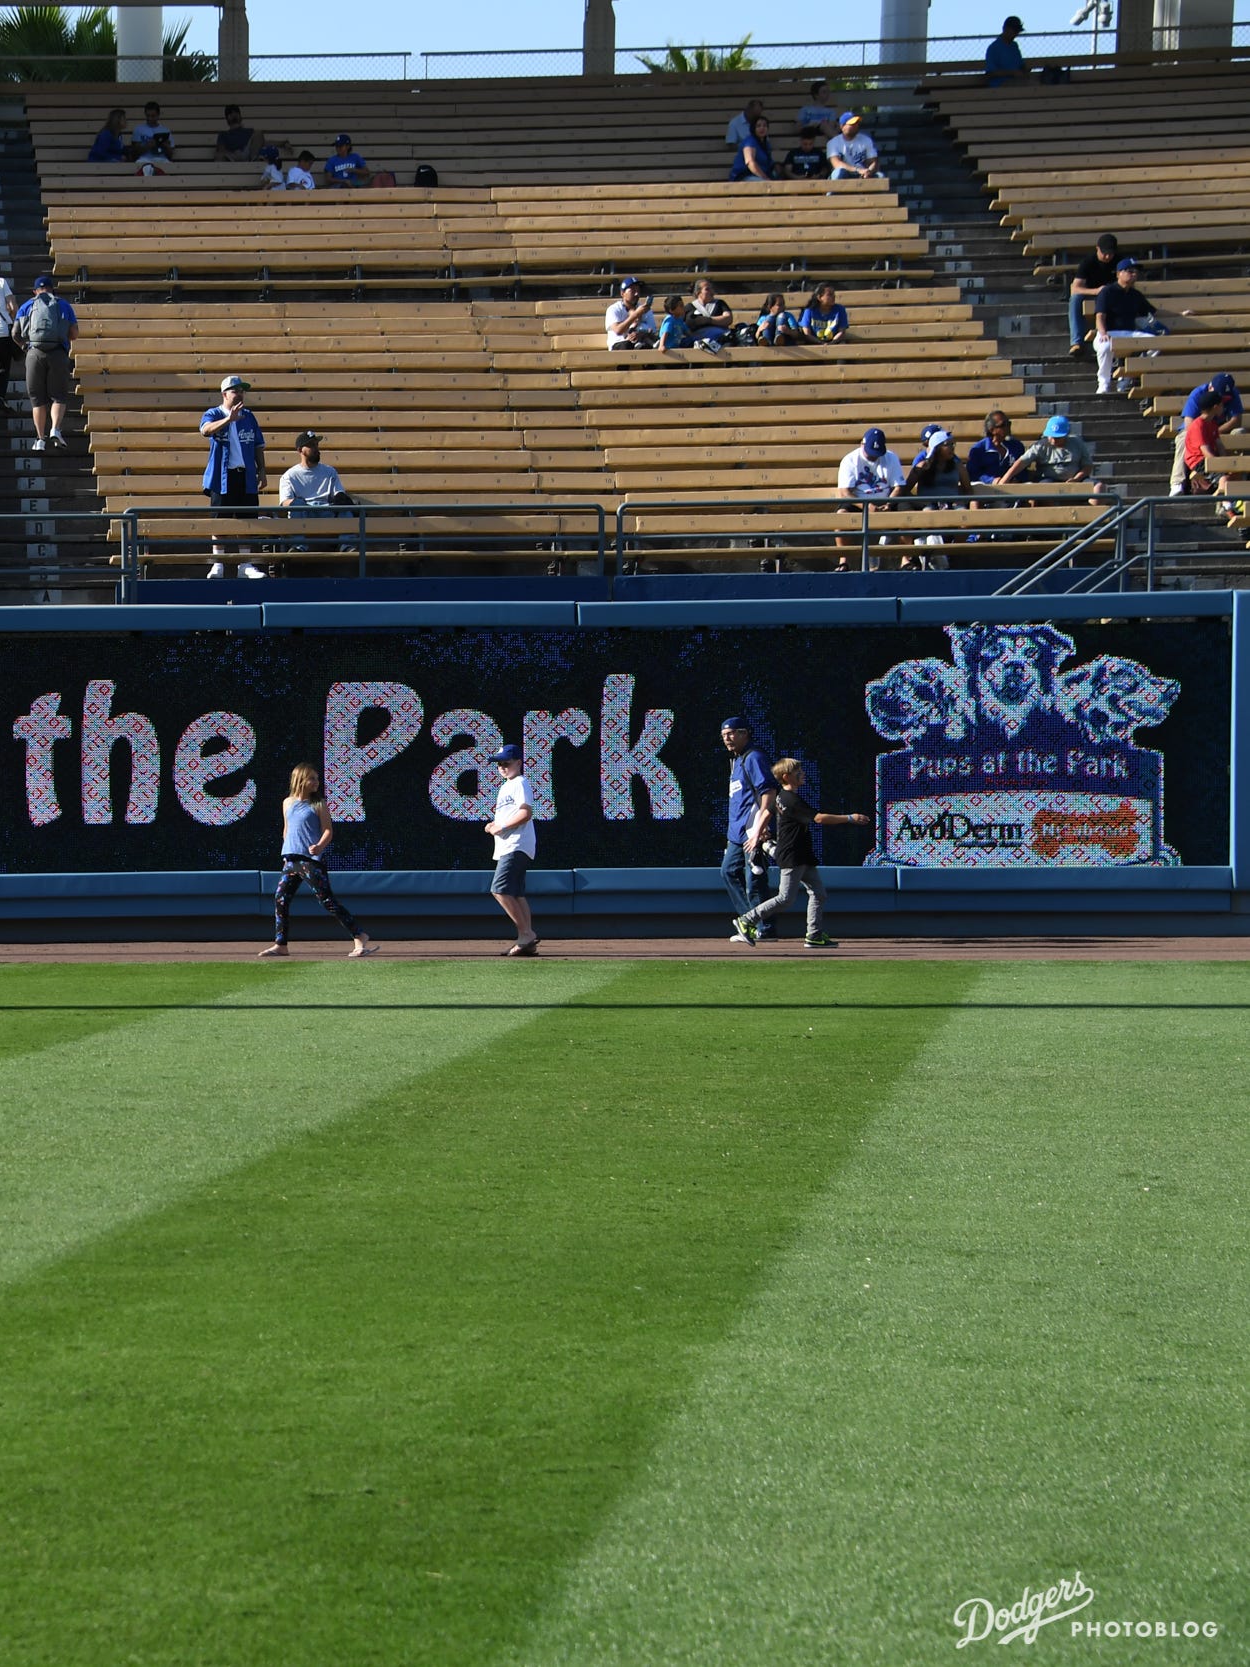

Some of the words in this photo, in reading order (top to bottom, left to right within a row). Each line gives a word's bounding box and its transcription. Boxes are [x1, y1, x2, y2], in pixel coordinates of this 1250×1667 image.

[13, 679, 257, 826] the
[324, 674, 685, 822] Park
[909, 755, 974, 782] Pups
[980, 752, 1007, 774] at
[1015, 749, 1059, 774] the
[1066, 750, 1131, 779] Park
[895, 812, 1025, 846] AvoDerm
